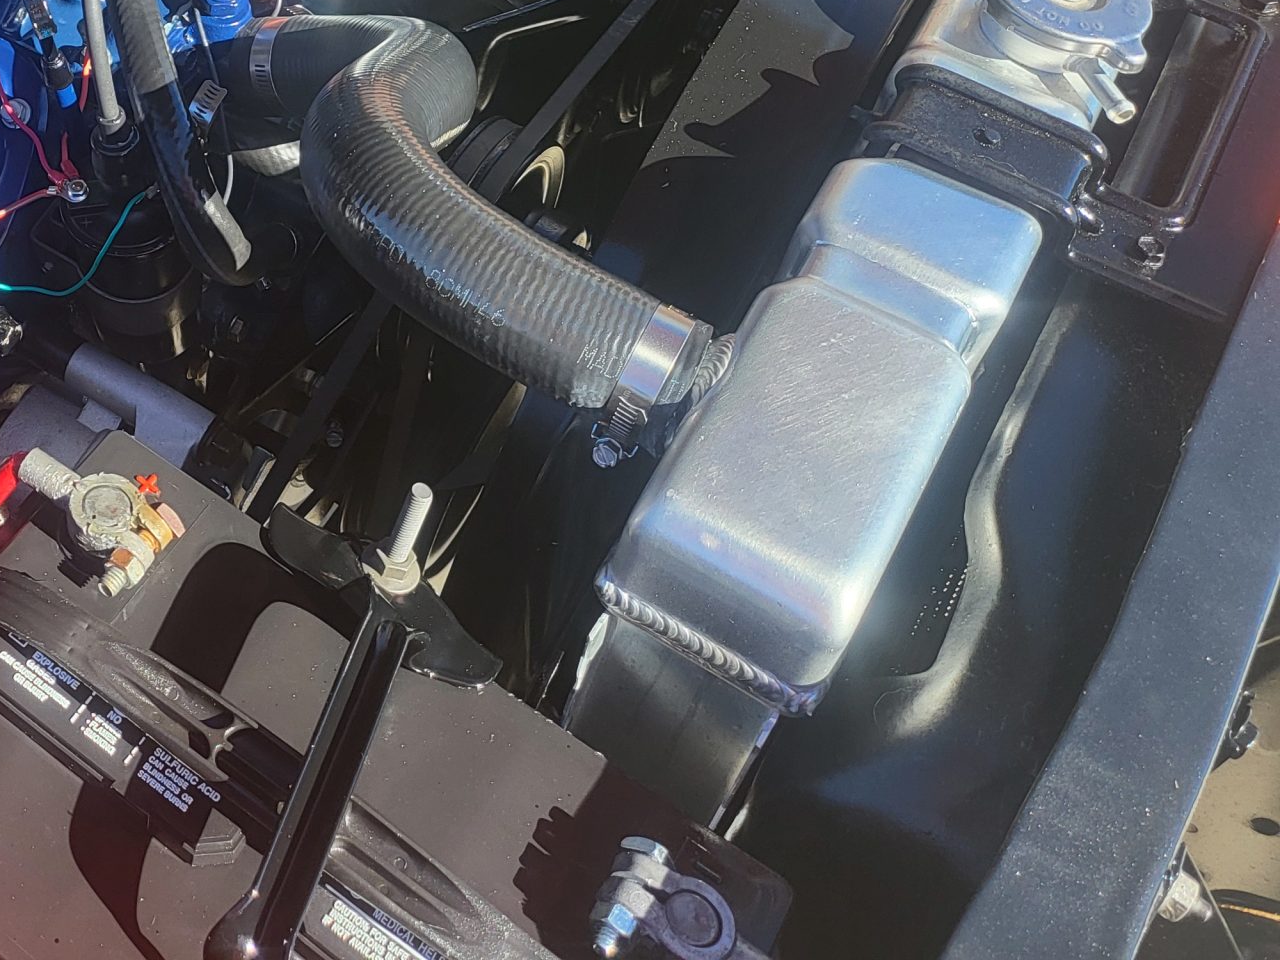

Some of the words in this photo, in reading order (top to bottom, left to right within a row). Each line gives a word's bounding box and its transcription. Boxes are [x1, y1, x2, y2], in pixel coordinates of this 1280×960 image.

[575, 342, 626, 381] MAD
[12, 661, 35, 681] CAUSE
[32, 677, 70, 708] BLINDNESS
[12, 673, 24, 684] OR
[22, 680, 48, 702] INJURY
[25, 659, 56, 684] GASES
[32, 651, 80, 689] EXPLOSIVE
[88, 720, 117, 744] FLAMES
[106, 710, 122, 724] NO
[83, 727, 116, 754] SMOKING
[142, 763, 181, 794] BLINDNESS
[180, 792, 193, 804] OR
[147, 755, 164, 770] CAN
[163, 768, 189, 789] CAUSE
[152, 747, 201, 786] SULFURIC
[197, 782, 221, 802] ACID
[136, 770, 165, 793] SEVERE
[163, 790, 189, 812] BURNS
[327, 909, 386, 956] INSTRUCTIONS
[330, 923, 350, 940] NOT
[369, 928, 387, 944] FOR
[386, 941, 408, 960] SAFE
[372, 909, 417, 945] MEDICAL
